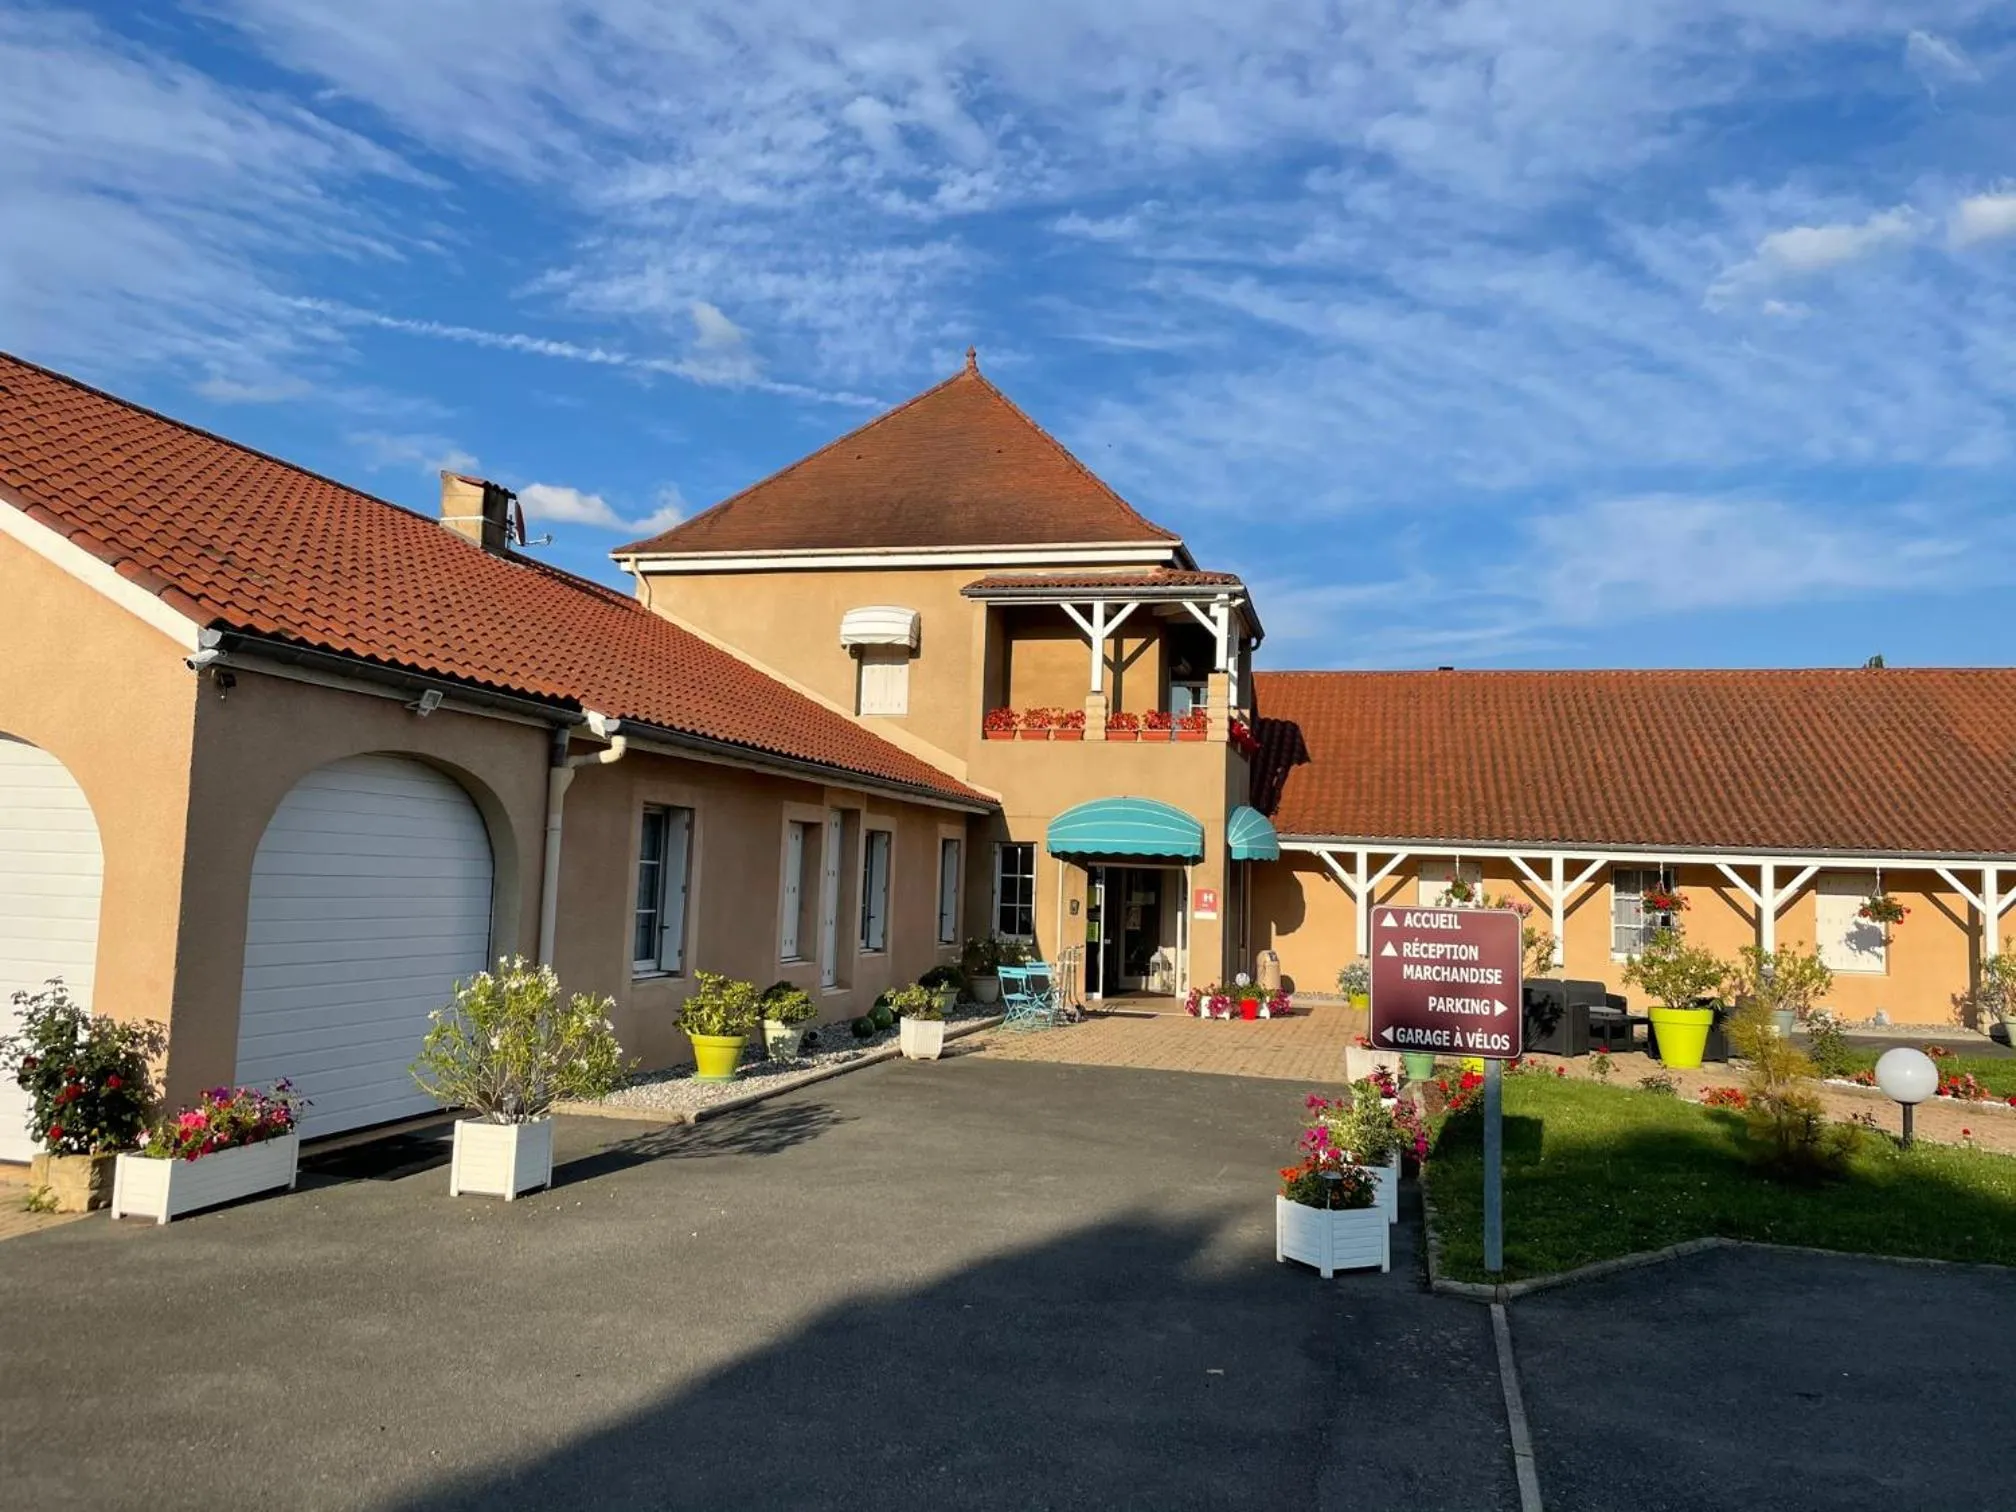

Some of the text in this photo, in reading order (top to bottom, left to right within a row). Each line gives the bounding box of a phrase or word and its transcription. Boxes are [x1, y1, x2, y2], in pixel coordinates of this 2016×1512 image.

[1404, 912, 1461, 929] ACCUEIL
[1403, 938, 1479, 961] RÉCEPTION
[1403, 964, 1503, 984] MARCHANDISE
[1428, 996, 1490, 1015] PARKING
[1396, 1026, 1510, 1050] GARAGE À VÉLOS
